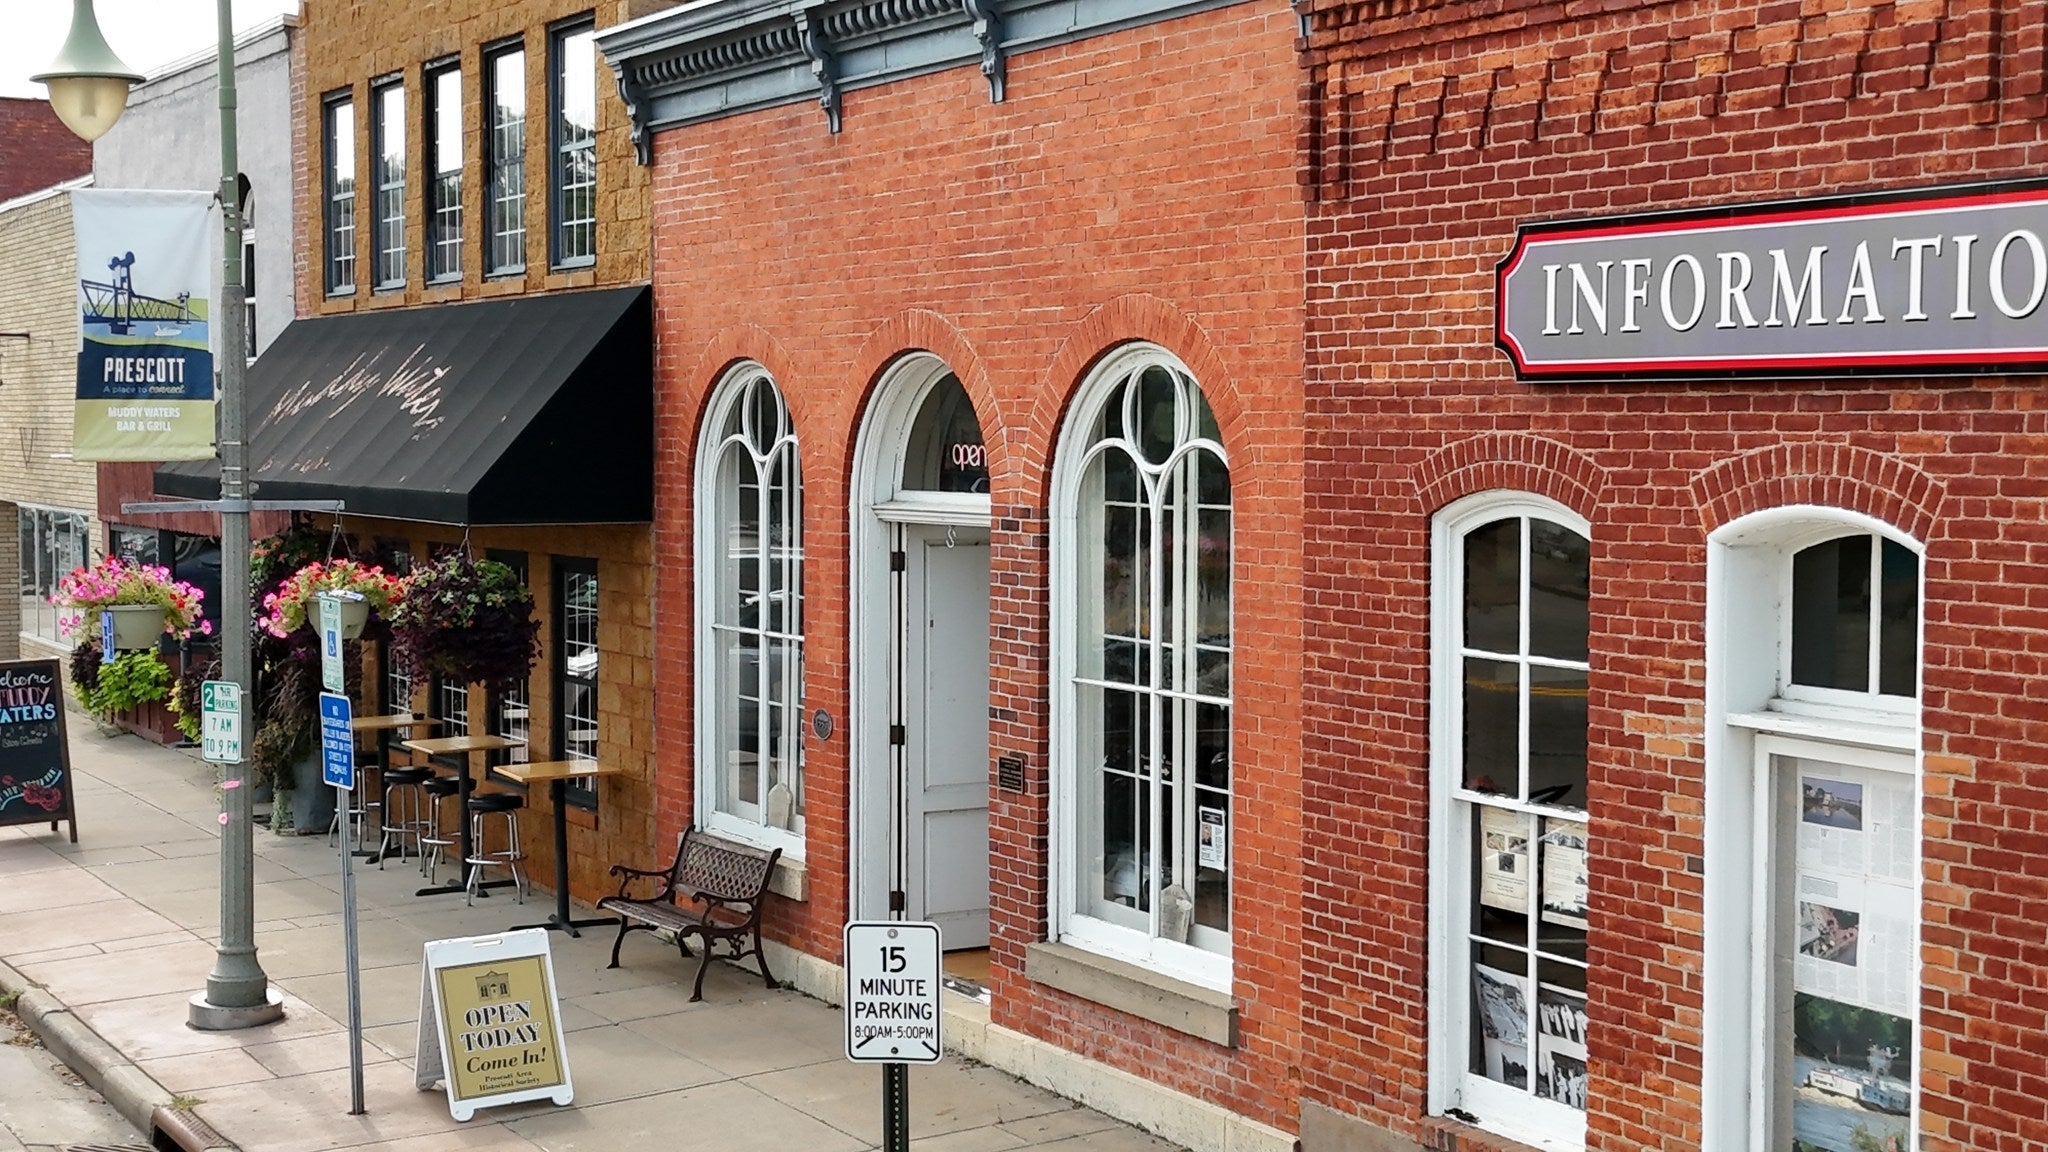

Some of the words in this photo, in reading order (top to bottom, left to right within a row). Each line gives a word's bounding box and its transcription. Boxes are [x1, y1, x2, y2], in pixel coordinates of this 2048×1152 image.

[1541, 232, 2048, 336] INFORMATIO
[104, 357, 185, 383] PRESCOTT
[103, 385, 111, 393] A
[112, 386, 136, 394] place
[138, 386, 148, 394] to
[108, 407, 143, 418] MUDDY
[143, 407, 181, 418] WATERS
[116, 421, 136, 431] BAR
[137, 421, 145, 431] &
[146, 421, 172, 431] GRILL
[952, 443, 988, 472] open
[0, 670, 53, 688] elcome
[204, 687, 214, 708] 2
[222, 687, 231, 697] HR
[216, 699, 238, 710] PARKING
[0, 703, 56, 724] ATERS
[212, 717, 217, 731] 7
[220, 718, 232, 732] AM
[205, 738, 215, 752] TO
[218, 740, 224, 753] 9
[226, 740, 238, 753] PM
[880, 946, 907, 973] 15
[860, 978, 927, 997] MINUTE
[465, 1001, 530, 1027] OPEN
[855, 1001, 933, 1021] PARKING
[460, 1022, 541, 1052] TODAY
[854, 1025, 934, 1040] 8:00AM-5:00PM
[466, 1056, 518, 1074] Come
[522, 1046, 547, 1066] In!
